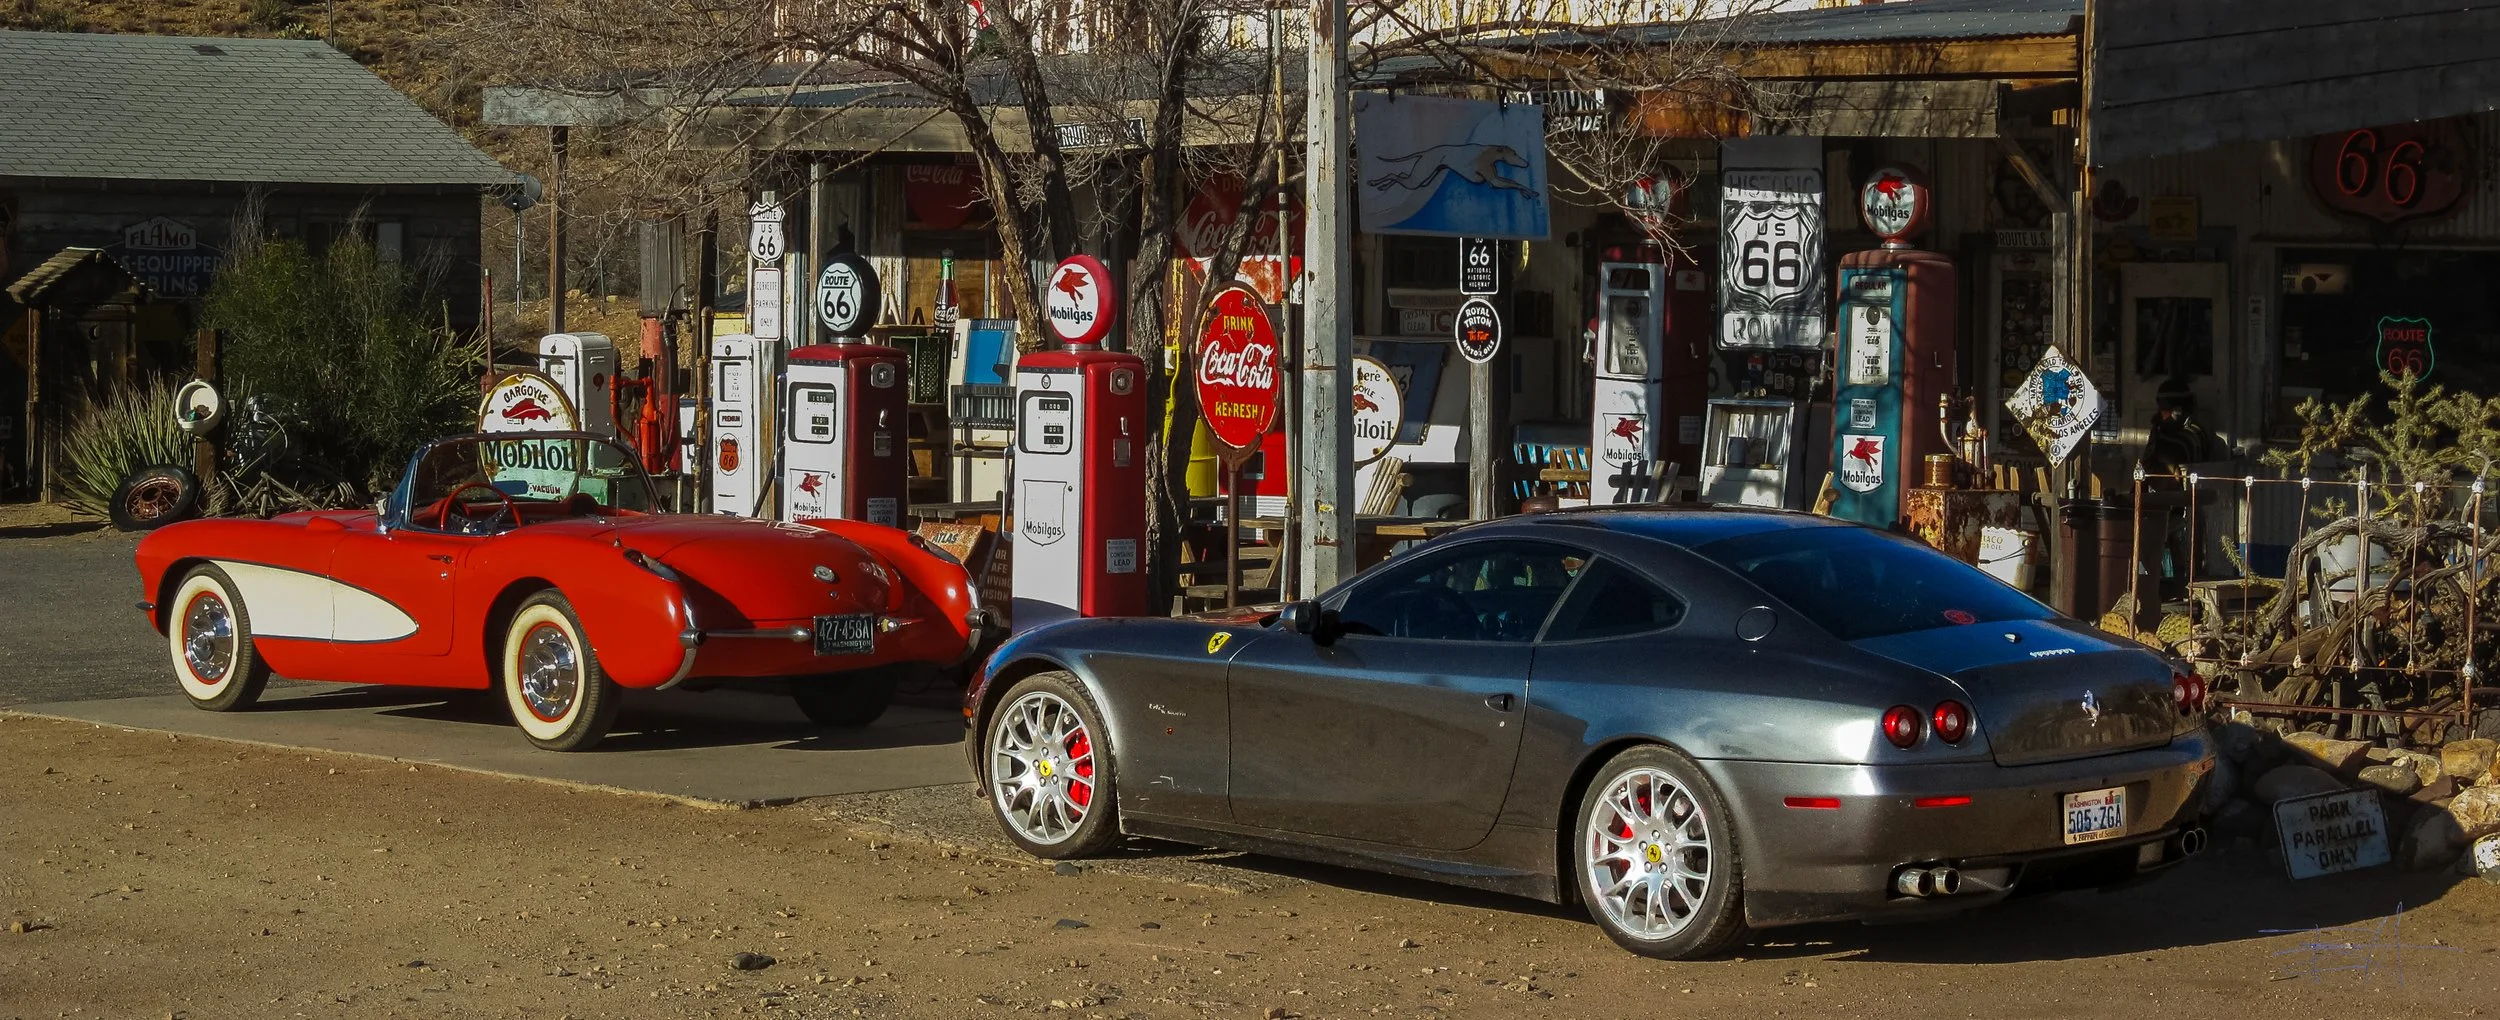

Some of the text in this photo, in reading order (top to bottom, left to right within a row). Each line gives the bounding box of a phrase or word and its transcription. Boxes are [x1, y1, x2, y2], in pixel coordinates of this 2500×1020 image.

[2336, 128, 2425, 205] 66
[1729, 174, 1815, 199] HISTORIC
[1866, 204, 1910, 221] Mobilgas
[130, 224, 191, 246] FLAMO
[1999, 231, 2029, 247] ROUTE
[757, 236, 776, 256] 66
[1469, 246, 1490, 265] 66
[1743, 239, 1800, 288] 66
[825, 276, 849, 286] ROUTE
[1855, 281, 1887, 290] REGULAR
[824, 290, 851, 319] 66
[1465, 307, 1490, 317] ROYAL
[1050, 306, 1093, 324] Mobilgas
[1224, 315, 1254, 331] DRINK
[1430, 310, 1456, 332] IC
[1464, 316, 1492, 328] TRITON
[1732, 317, 1808, 341] ROUTE
[2384, 327, 2425, 342] ROUTE
[1483, 340, 1495, 355] OILS
[1201, 341, 1274, 390] Coca-Cola
[2387, 347, 2423, 377] 66
[1353, 384, 1376, 399] GOYLE
[1856, 415, 1871, 423] LEAD
[2070, 407, 2100, 436] ANGELES
[723, 454, 734, 467] 66
[1606, 448, 1642, 461] Mobilgas
[1843, 470, 1881, 486] Mobilgas
[793, 502, 823, 516] Mobilgas
[793, 513, 822, 522] SPECI
[932, 533, 958, 543] ATLAS
[1026, 521, 1062, 539] Mobilgas
[991, 562, 1008, 574] AFE
[1113, 558, 1131, 567] LEAD
[833, 639, 871, 649] WASHINGTON
[2069, 798, 2102, 809] WASHINGTON
[2309, 800, 2351, 821] PARK
[2292, 819, 2377, 848] PARALLEL
[2318, 844, 2358, 868] ONLY
